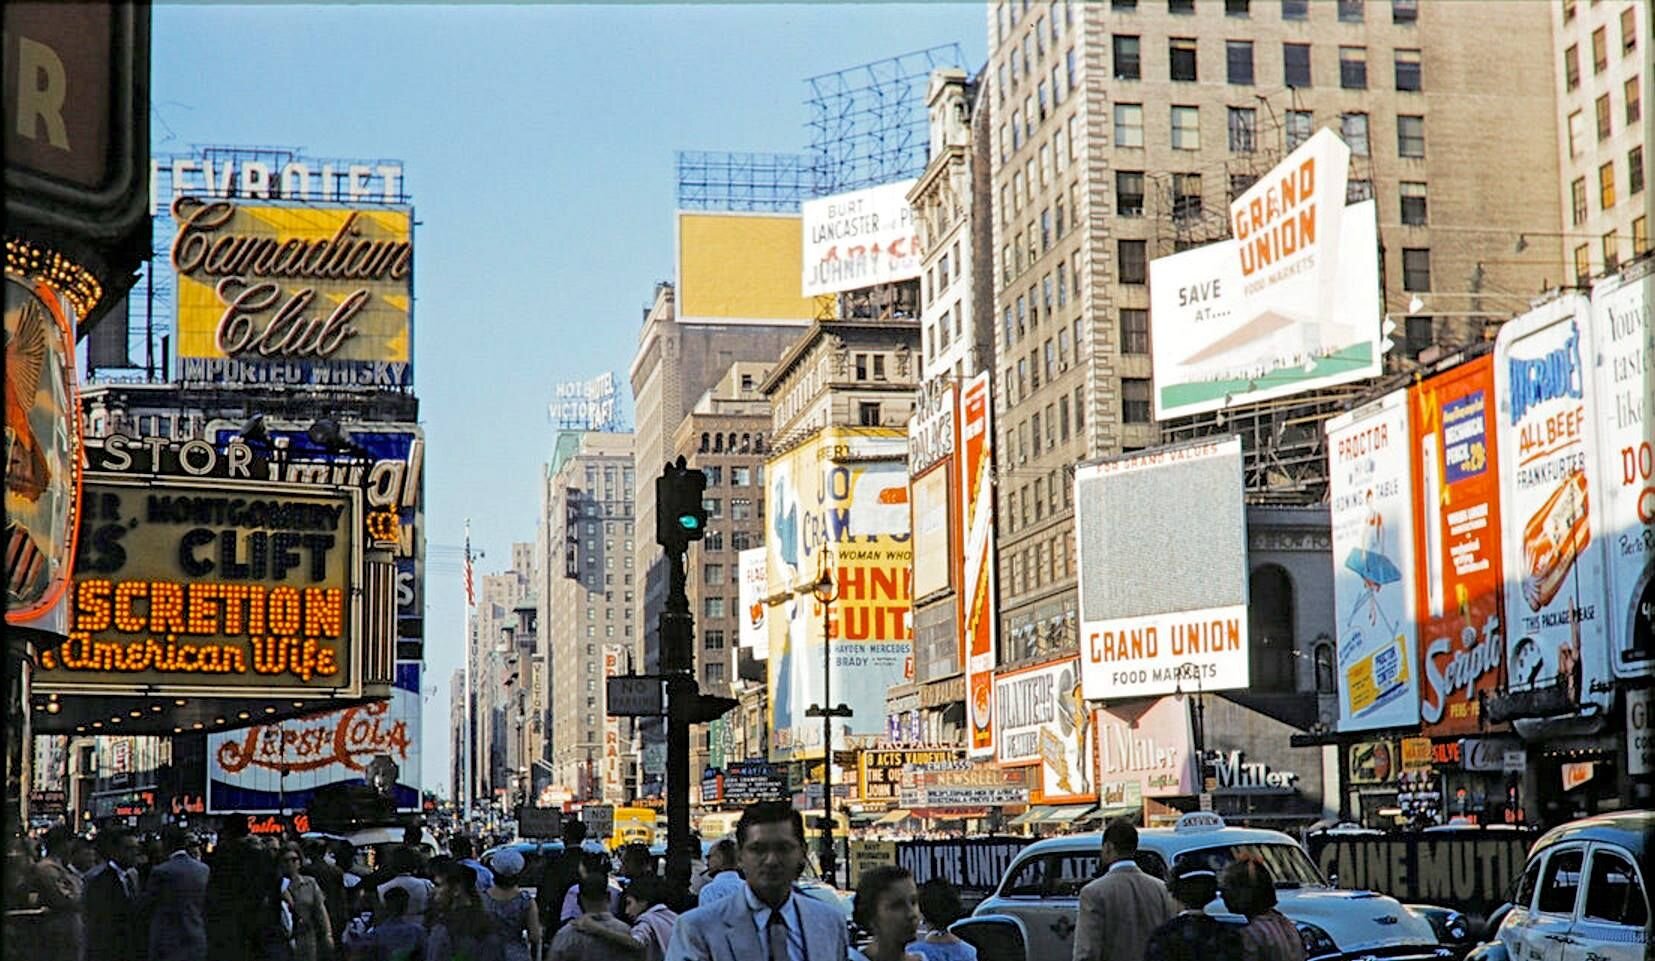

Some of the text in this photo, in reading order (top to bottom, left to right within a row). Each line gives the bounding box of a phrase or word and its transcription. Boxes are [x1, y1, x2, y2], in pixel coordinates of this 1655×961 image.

[828, 199, 864, 219] BURT
[1234, 157, 1315, 242] GRAND
[171, 196, 411, 279] Canadian
[812, 213, 880, 245] LANCASTER
[1240, 203, 1317, 278] UNION
[1178, 278, 1222, 308] SAVE
[216, 277, 371, 357] Club
[177, 358, 409, 386] IMPORTED WHISKY
[1338, 423, 1388, 463] PROCTOR
[1519, 424, 1544, 456] ALL
[1546, 405, 1584, 445] BEEF
[1170, 445, 1218, 462] VALUES
[147, 495, 344, 531] MONTGOMERY
[180, 527, 335, 581] CLIFT
[839, 551, 912, 560] WOMAN WHO
[77, 579, 343, 637] SCRETION
[61, 630, 338, 682] American Wife
[869, 644, 911, 654] MERCEDES
[1090, 618, 1240, 664] GRAND UNION
[836, 656, 869, 667] BRADY
[1112, 663, 1217, 686] FOOD MARKETS
[1421, 615, 1503, 724] Scripto
[606, 732, 618, 784] RAIL
[877, 753, 902, 766] ACTS
[1118, 722, 1178, 773] Miller
[867, 769, 884, 782] THE
[937, 774, 1000, 786] NEWSREEL
[1213, 749, 1295, 789] Miller
[867, 785, 891, 797] JOHN
[1183, 817, 1219, 828] SKYVIEW
[899, 845, 932, 884] JOIN
[934, 847, 962, 886] THE
[1319, 841, 1408, 896] CAINE
